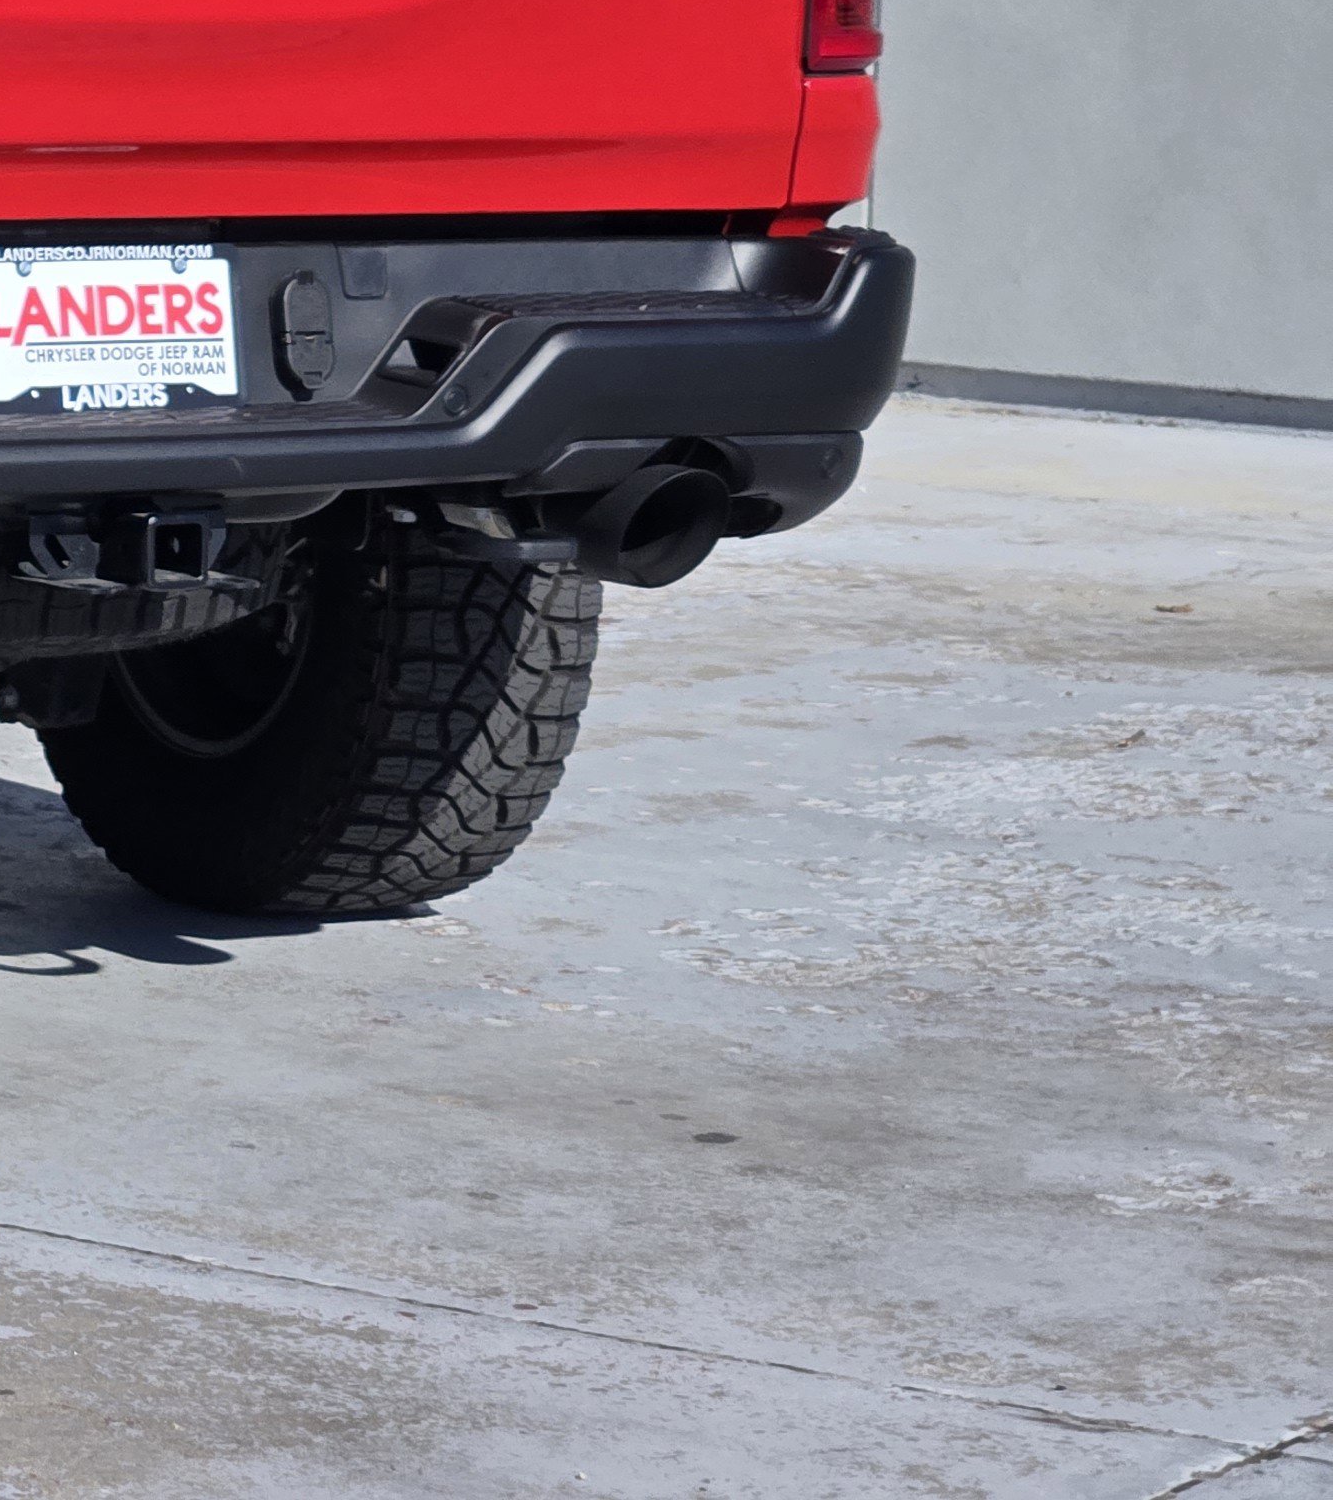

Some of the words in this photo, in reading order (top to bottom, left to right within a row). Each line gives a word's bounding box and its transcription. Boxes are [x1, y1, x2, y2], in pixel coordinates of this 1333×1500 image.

[25, 347, 96, 363] CHRYSLER
[100, 346, 153, 361] DODGE
[157, 345, 188, 360] JEEP
[192, 345, 224, 359] RAM
[138, 362, 157, 377] OF
[161, 361, 226, 376] NORMAN
[62, 384, 169, 412] LANDERS
